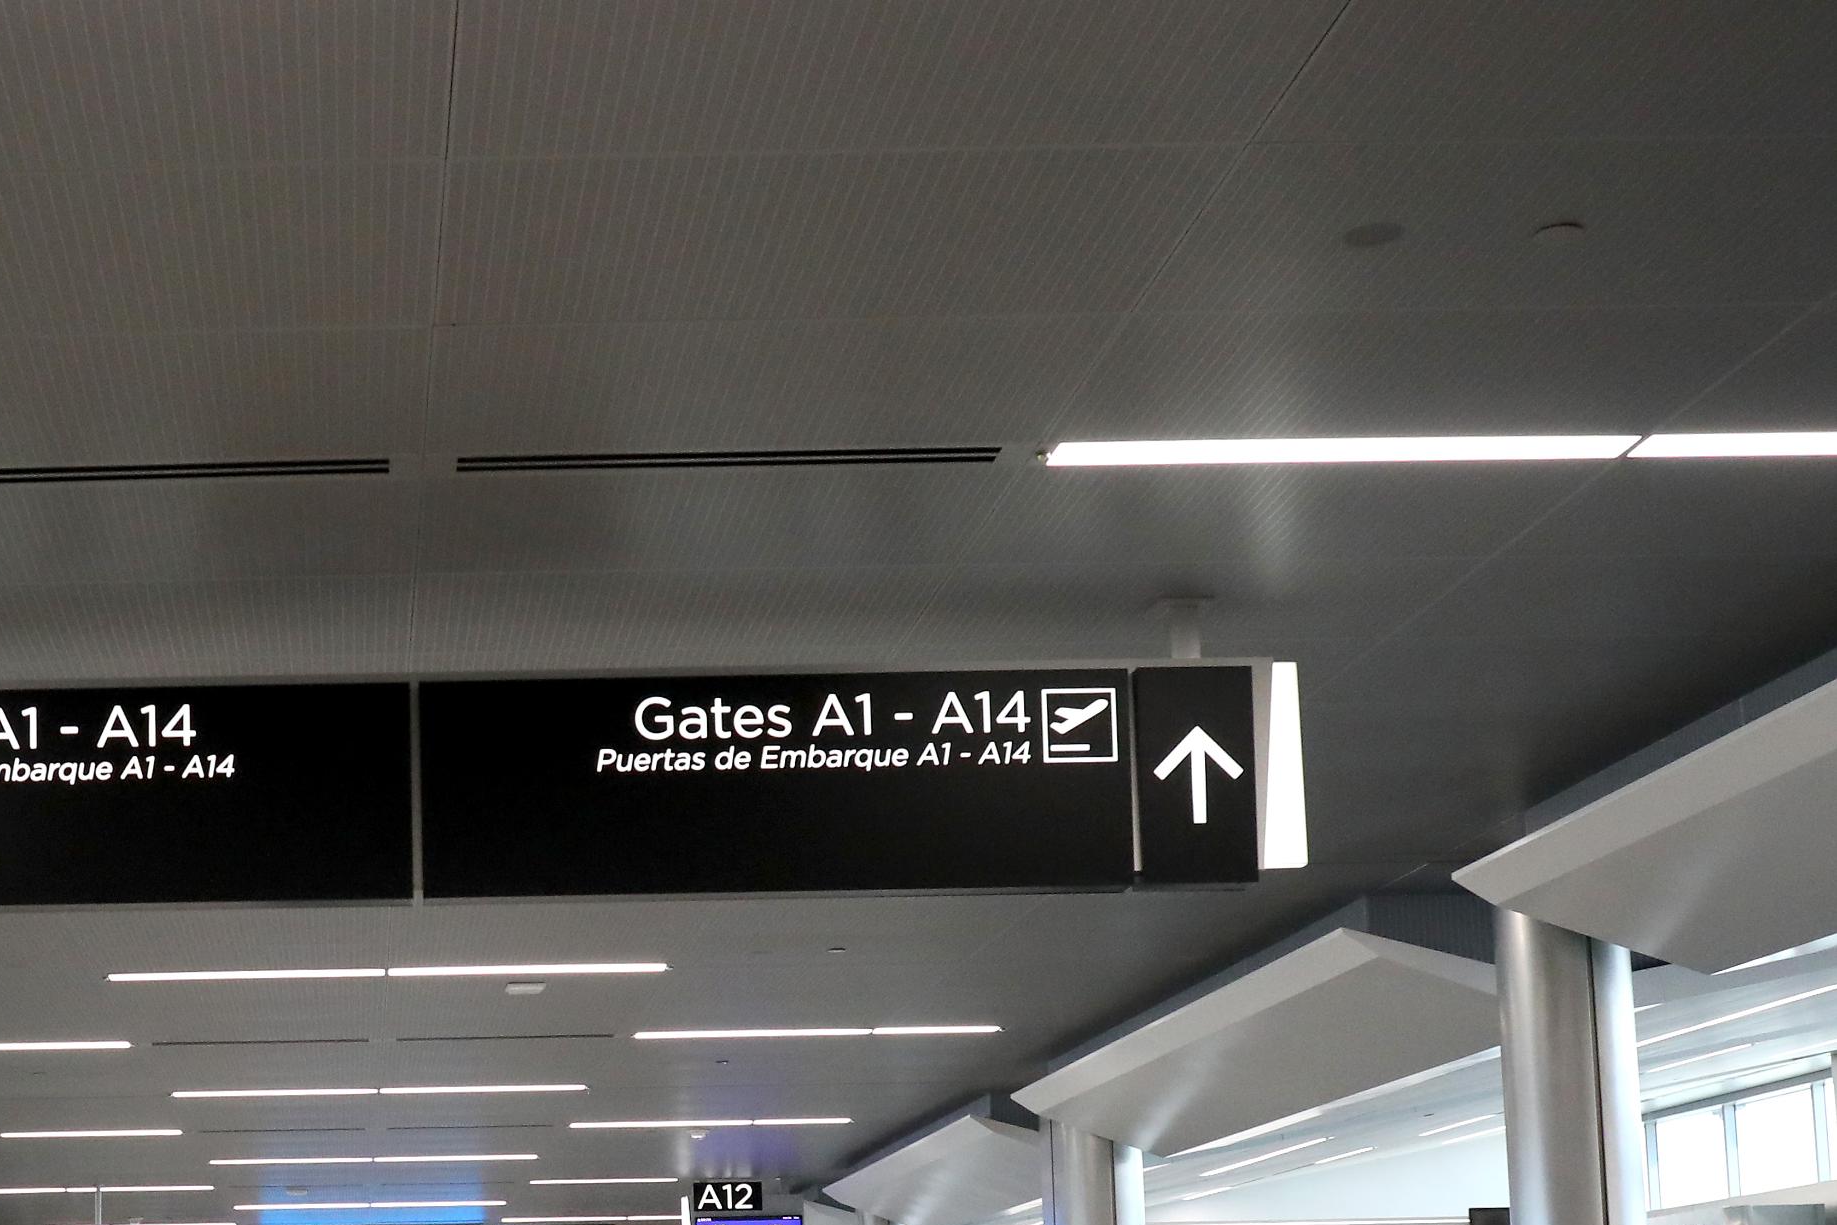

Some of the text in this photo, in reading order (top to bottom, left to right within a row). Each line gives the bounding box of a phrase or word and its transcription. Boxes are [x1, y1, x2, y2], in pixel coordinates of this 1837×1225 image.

[60, 725, 79, 734] -
[97, 704, 197, 748] A14
[633, 690, 1031, 740] Gates A1 - A14
[121, 756, 154, 779] A1
[182, 754, 235, 778] A14
[597, 748, 705, 772] Puertas
[715, 746, 751, 770] de
[761, 744, 909, 773] Embarque
[917, 743, 951, 766] A1
[979, 741, 1031, 765] A14
[697, 1183, 753, 1210] A12
